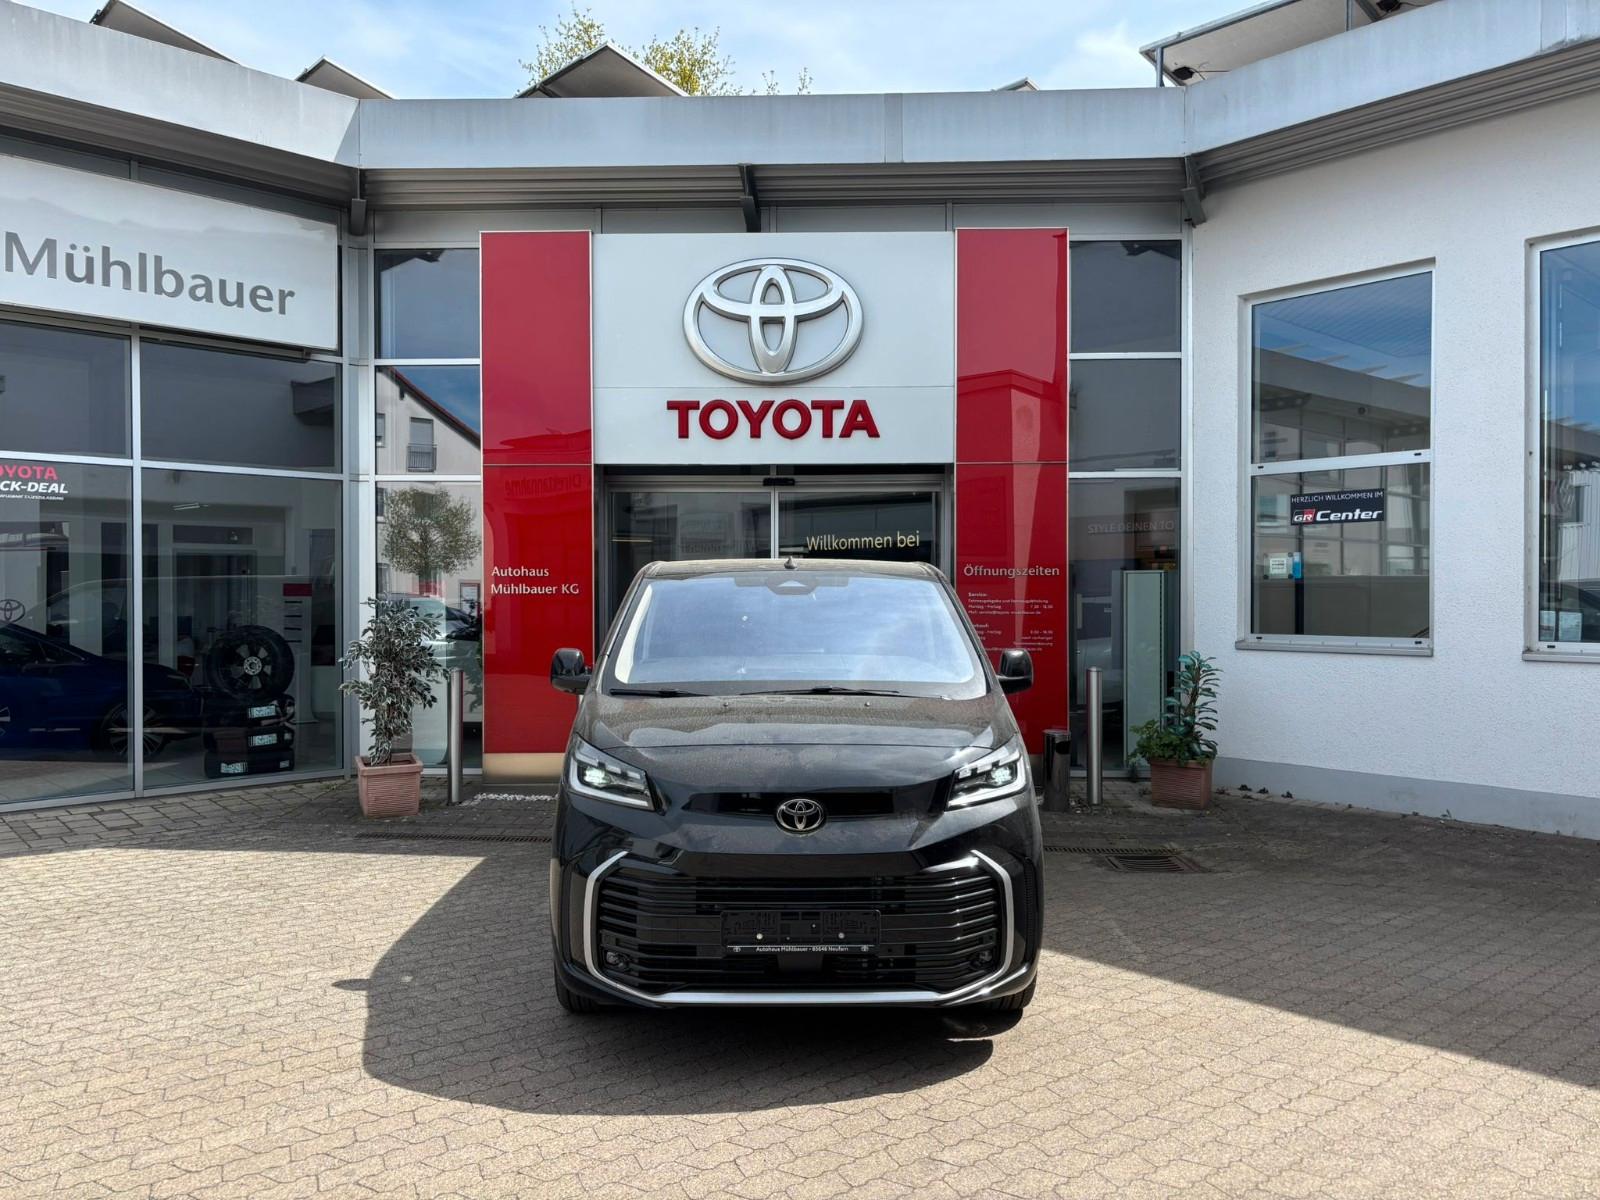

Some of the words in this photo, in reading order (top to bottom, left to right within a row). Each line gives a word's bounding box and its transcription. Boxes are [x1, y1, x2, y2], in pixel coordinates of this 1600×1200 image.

[4, 231, 296, 316] Mühlbauer
[666, 398, 881, 440] TOYOTA
[1291, 495, 1324, 504] HERZLICH
[1325, 492, 1373, 501] WILLKOMMEN
[1374, 491, 1384, 499] IM
[1315, 508, 1384, 522] Center
[806, 534, 893, 551] Willkommen
[896, 530, 920, 548] bei
[491, 566, 550, 577] Autohaus
[963, 563, 1060, 579] Öffnungszeiten
[490, 583, 557, 594] Mühlbauer
[561, 583, 580, 594] KG
